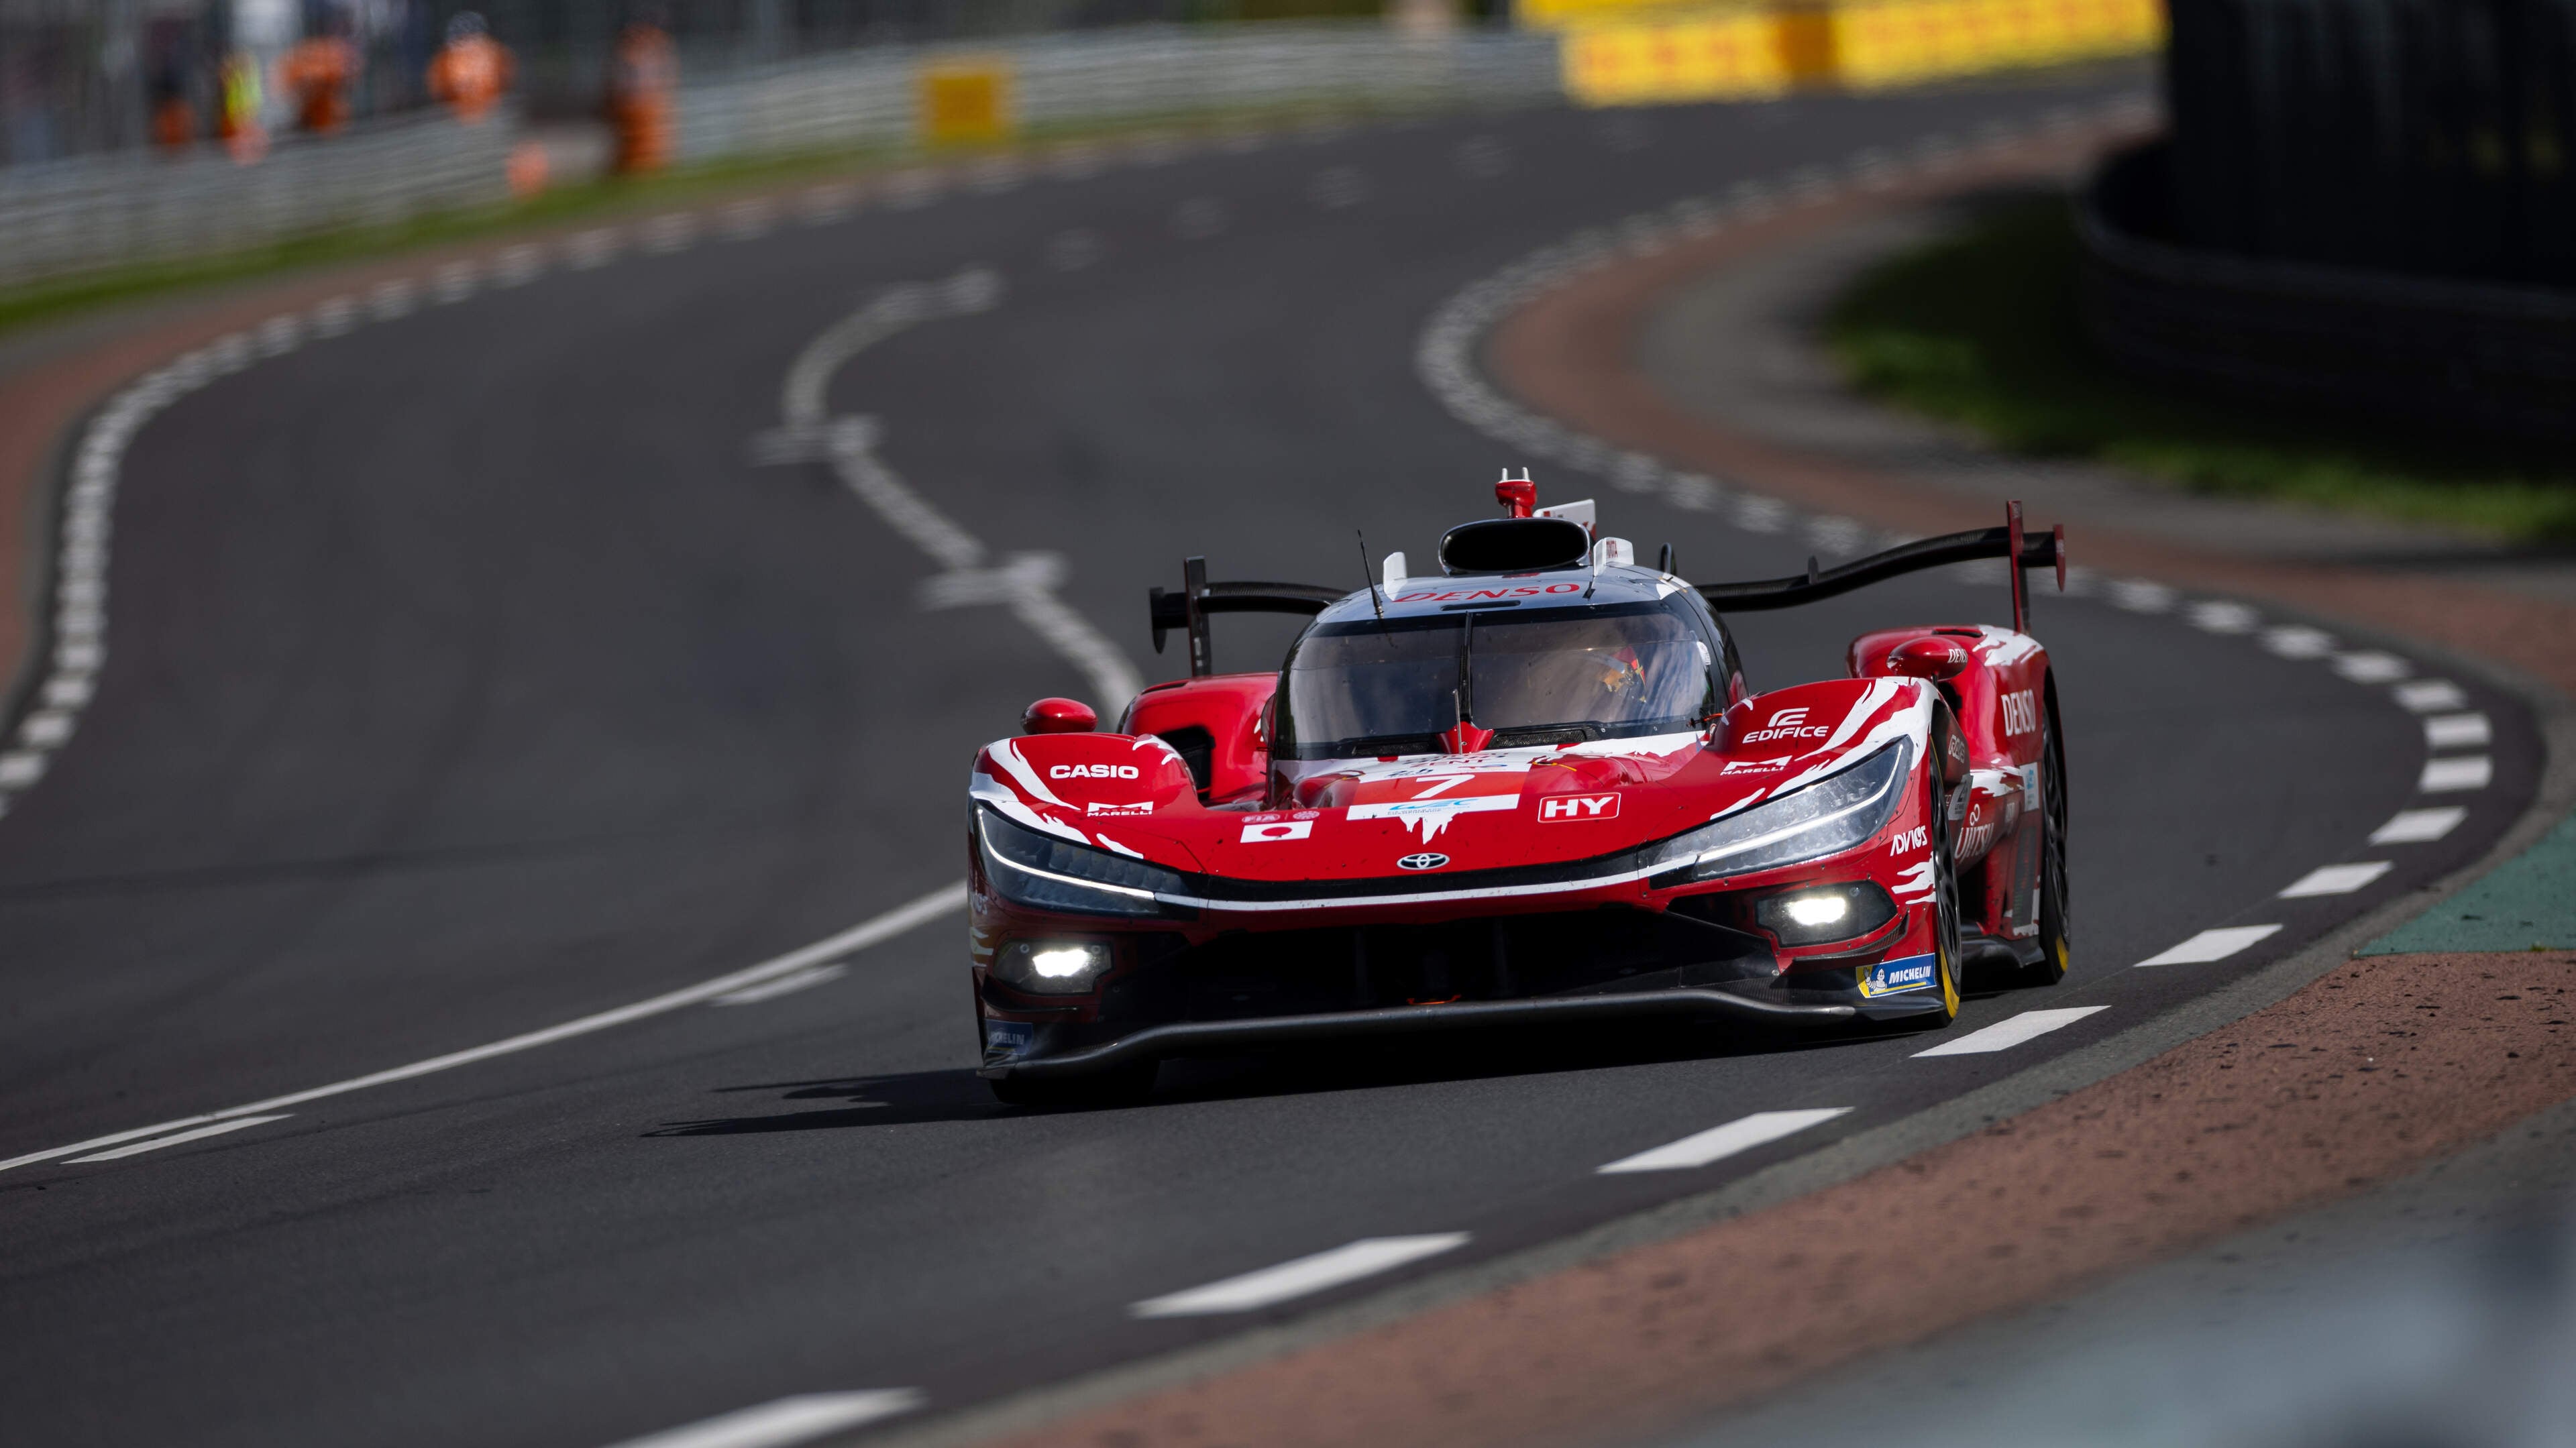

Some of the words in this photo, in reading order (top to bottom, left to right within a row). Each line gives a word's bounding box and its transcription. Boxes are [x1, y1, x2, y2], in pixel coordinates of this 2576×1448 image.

[1392, 583, 1580, 603] DENSO
[1947, 649, 1968, 663] DENS
[2000, 689, 2036, 737] DENSO
[1742, 726, 1829, 744] EDIFICE
[1050, 765, 1139, 779] CASIO
[1720, 766, 1784, 776] MARELLI
[1411, 773, 1476, 799] 7
[1544, 796, 1614, 818] HY
[1954, 822, 1994, 864] UJITSU
[1888, 965, 1931, 985] MICHELIN
